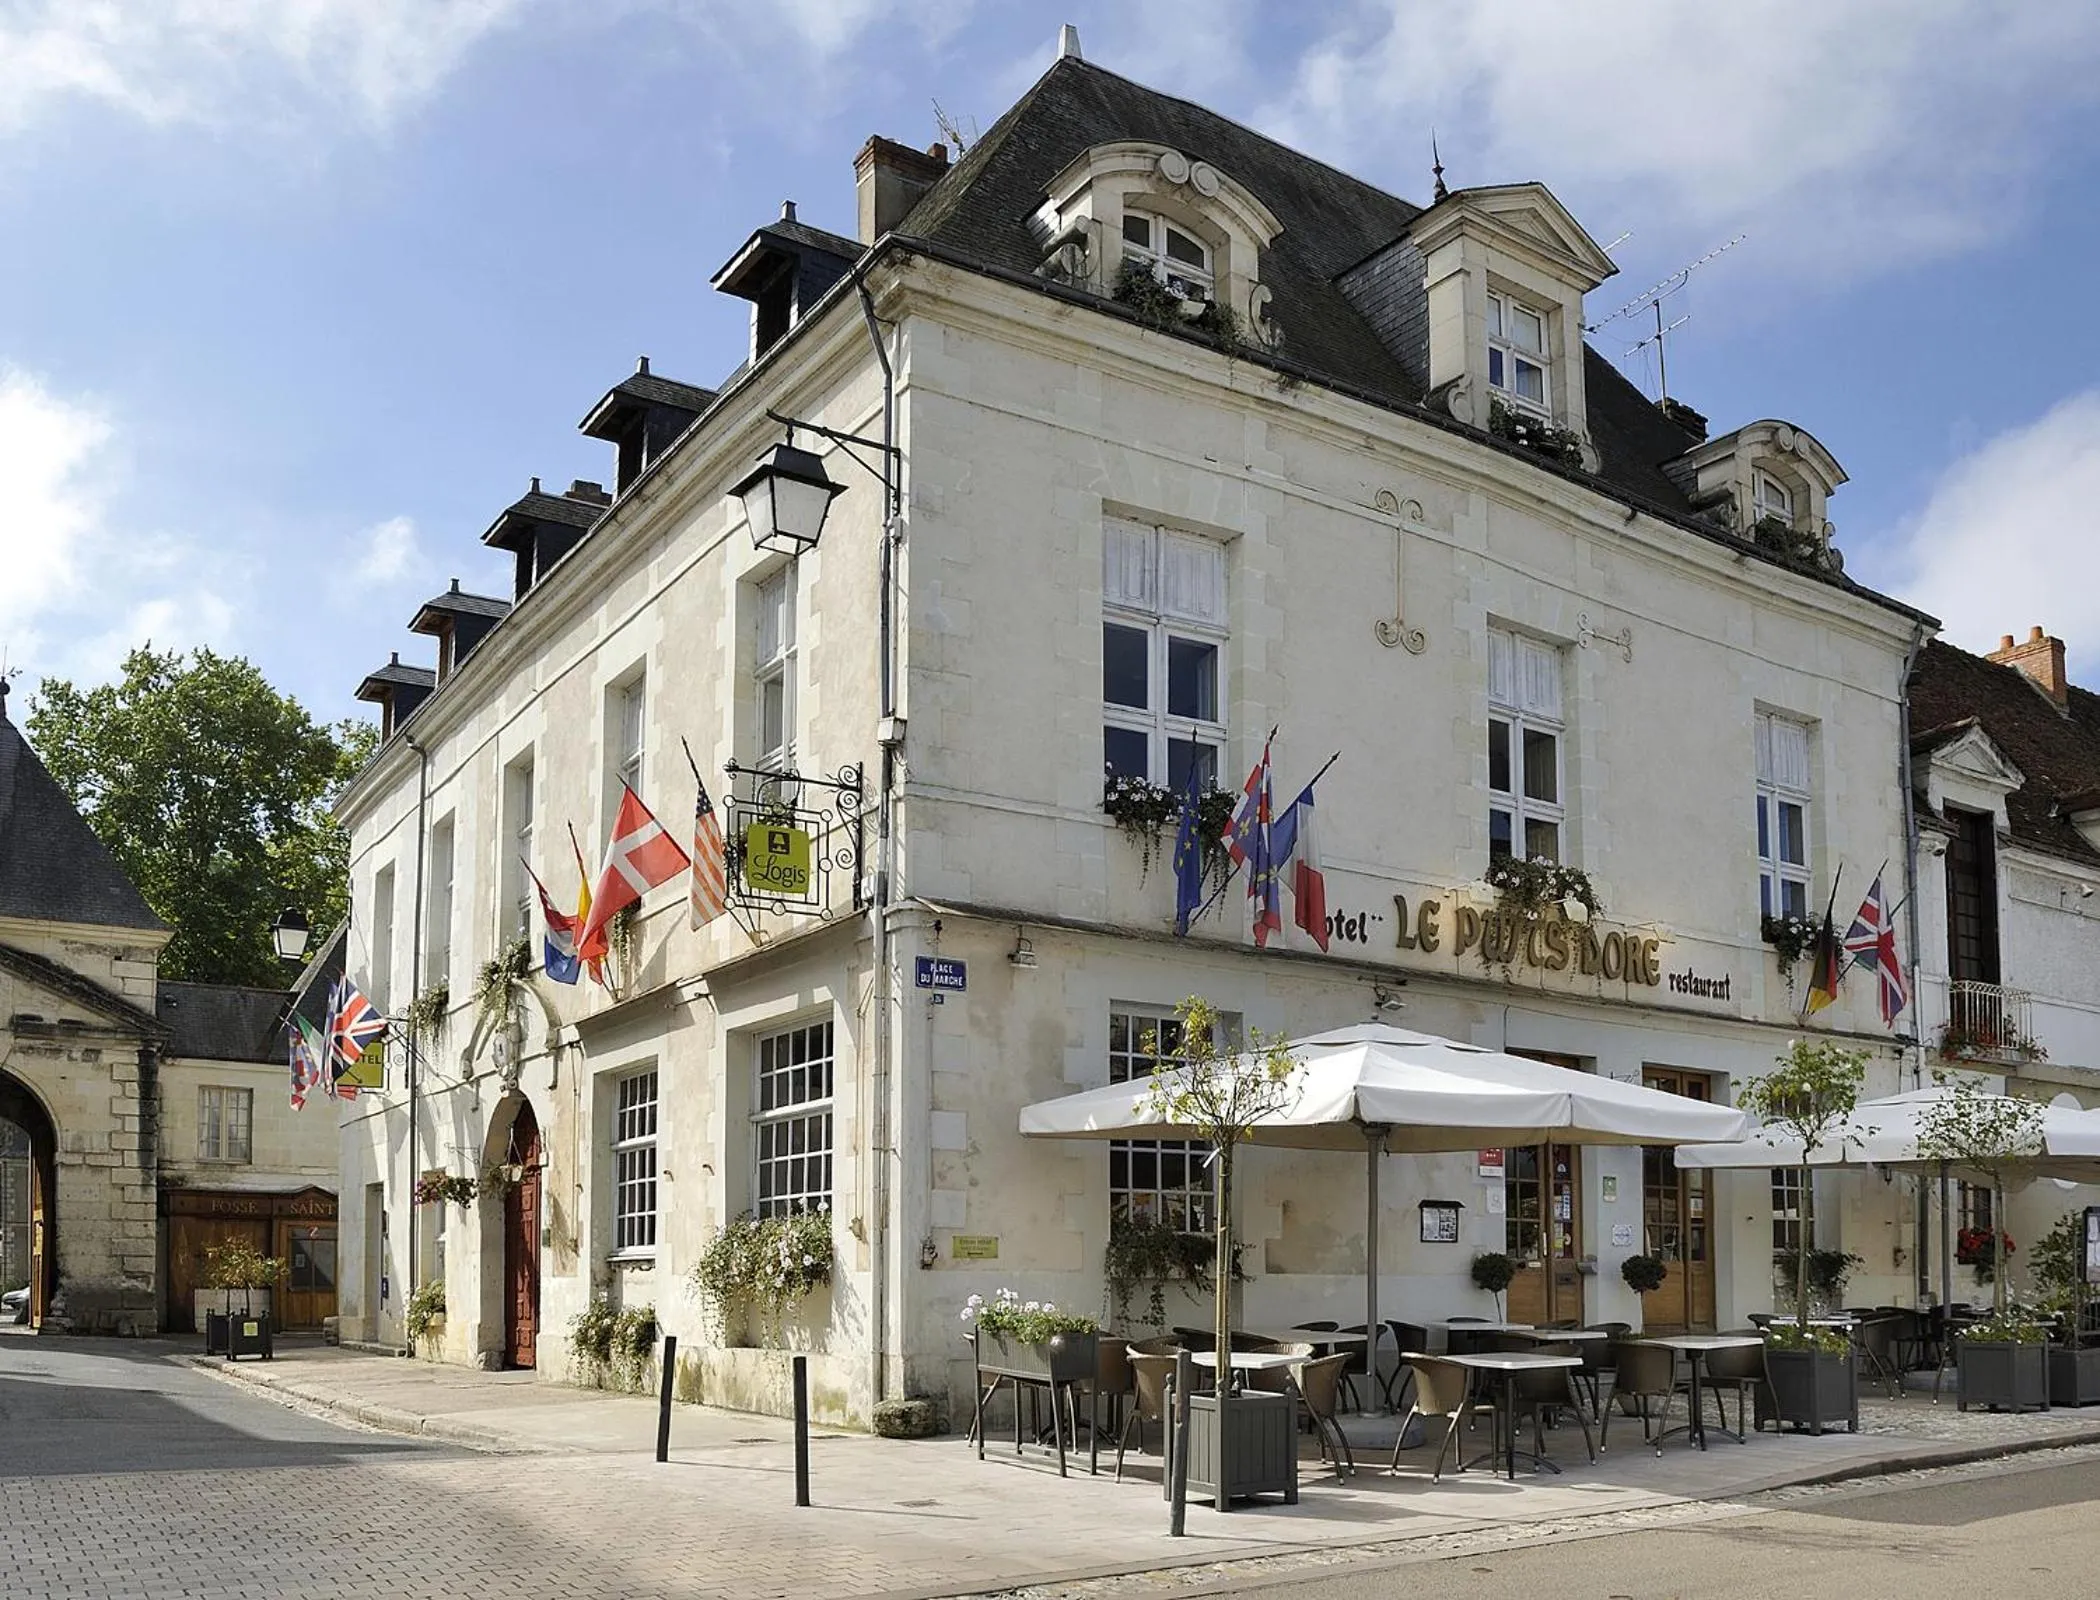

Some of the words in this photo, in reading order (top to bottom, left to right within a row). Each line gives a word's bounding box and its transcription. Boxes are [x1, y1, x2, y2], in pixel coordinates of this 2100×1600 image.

[752, 854, 806, 888] Logis
[1325, 908, 1368, 944] otel
[1668, 966, 1730, 1002] restaurant
[930, 963, 952, 973] PLACE
[920, 973, 930, 983] DU
[359, 1053, 381, 1064] TEL
[290, 1199, 335, 1215] SAINT
